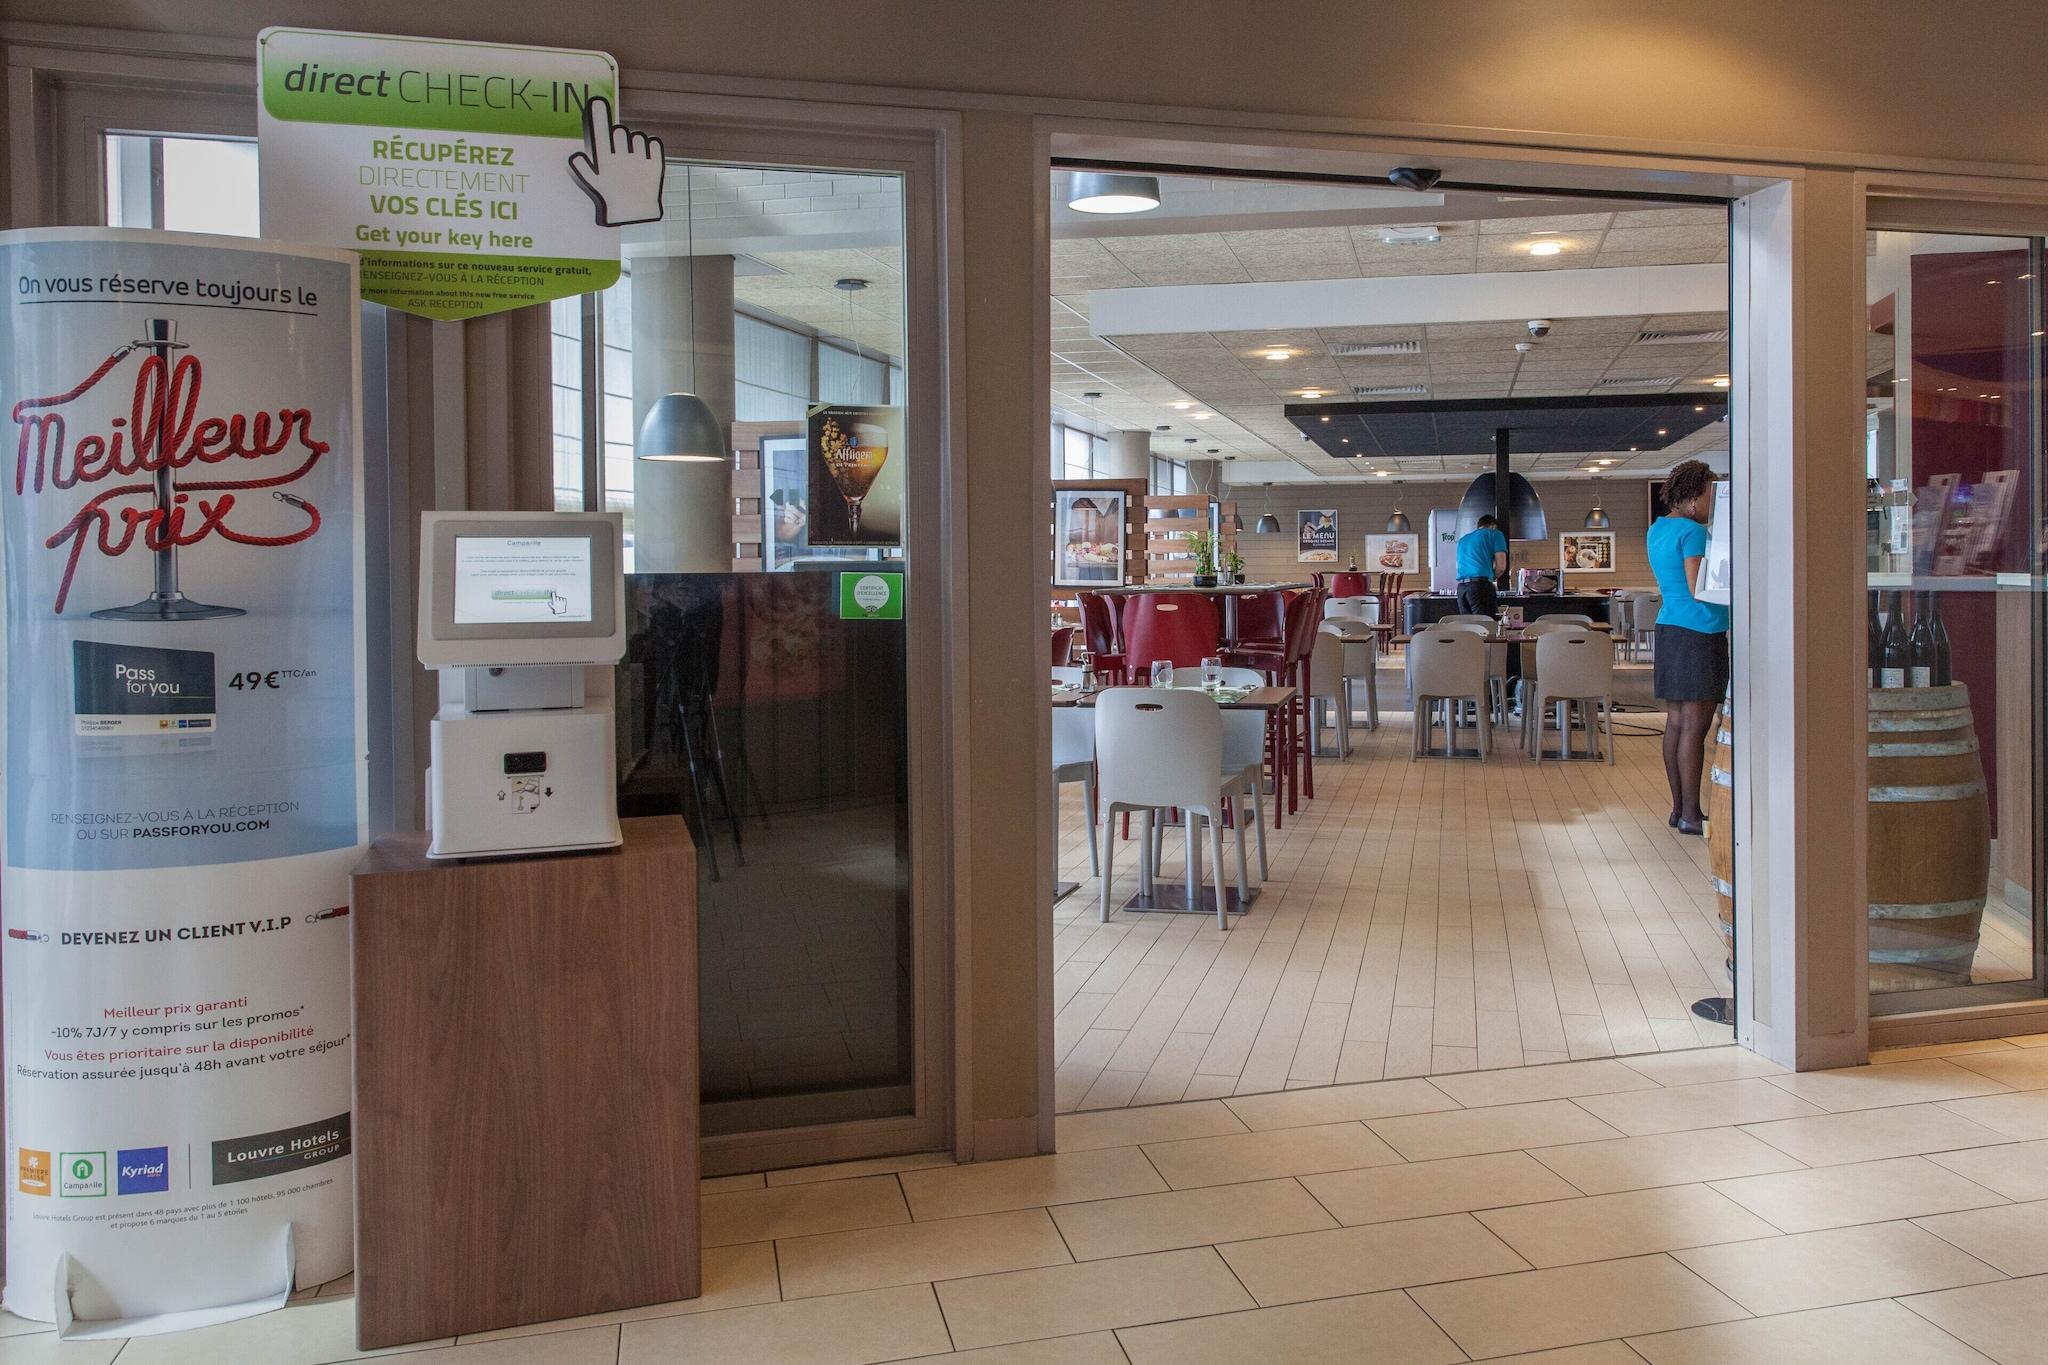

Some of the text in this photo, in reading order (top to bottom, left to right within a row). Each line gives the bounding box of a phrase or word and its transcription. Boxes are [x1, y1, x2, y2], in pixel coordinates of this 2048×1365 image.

[284, 63, 590, 114] direct CHECK-IN
[372, 135, 514, 167] RÉCUPÉREZ
[359, 165, 530, 194] DIRECTEMENT
[370, 192, 518, 221] VOS CLÉS ICI
[355, 224, 534, 250] Get your key here
[438, 262, 455, 270] sur
[471, 263, 515, 273] nouveau
[517, 265, 553, 274] service
[554, 265, 592, 276] gratuit,
[461, 272, 469, 284] À
[471, 275, 484, 284] LA
[486, 273, 545, 286] RÉCEPTION
[19, 273, 318, 306] On vous réserve toujours le
[389, 287, 434, 296] information
[436, 289, 458, 297] about
[492, 291, 507, 299] free
[509, 292, 535, 300] service
[408, 299, 483, 310] ASK RECEPTION
[13, 354, 330, 495] Meilleur
[835, 448, 873, 462] Affligem
[1441, 530, 1456, 542] Trop
[115, 663, 156, 682] Pass
[228, 668, 317, 691] 49€ TTC/an
[126, 680, 180, 697] for you
[51, 800, 300, 825] RENSEIGNEZ-VOUS À LA RÉCEPTION
[76, 819, 270, 840] OU SUR PASSFORYOU.COM
[61, 916, 292, 946] DEVENEZ UN CLIENT V.I.P
[104, 996, 248, 1019] Meilleur prix garanti
[51, 1026, 82, 1039] -10%
[86, 1025, 117, 1039] 7J/7
[120, 1027, 129, 1040] y
[132, 1022, 191, 1038] compris
[195, 1020, 218, 1032] sur
[222, 1015, 243, 1028] les
[44, 1025, 314, 1063] Vous êtes prioritaire sur la disponibilité
[17, 1064, 79, 1081] Réservation
[82, 1066, 136, 1080] assurée
[139, 1061, 191, 1079] jusqu'à
[194, 1058, 222, 1072] 48h
[225, 1055, 266, 1069] avant
[269, 1047, 306, 1061] votre
[227, 1129, 340, 1163] Louvre Hotels
[303, 1144, 340, 1160] GROUP
[122, 1163, 164, 1178] Kyriad
[63, 1181, 103, 1190] Campanile
[51, 1214, 72, 1222] Hotels
[72, 1214, 94, 1223] Group
[107, 1211, 134, 1221] présent
[136, 1209, 153, 1218] dans
[165, 1207, 182, 1217] pays
[184, 1205, 200, 1213] avec
[201, 1202, 217, 1212] plus
[218, 1201, 227, 1209] de
[236, 1198, 250, 1206] 100
[287, 1186, 301, 1195] 000
[302, 1177, 334, 1192] chambres
[119, 1218, 148, 1229] propose
[156, 1215, 188, 1225] marques
[188, 1213, 199, 1222] du
[224, 1207, 248, 1217] étoiles
